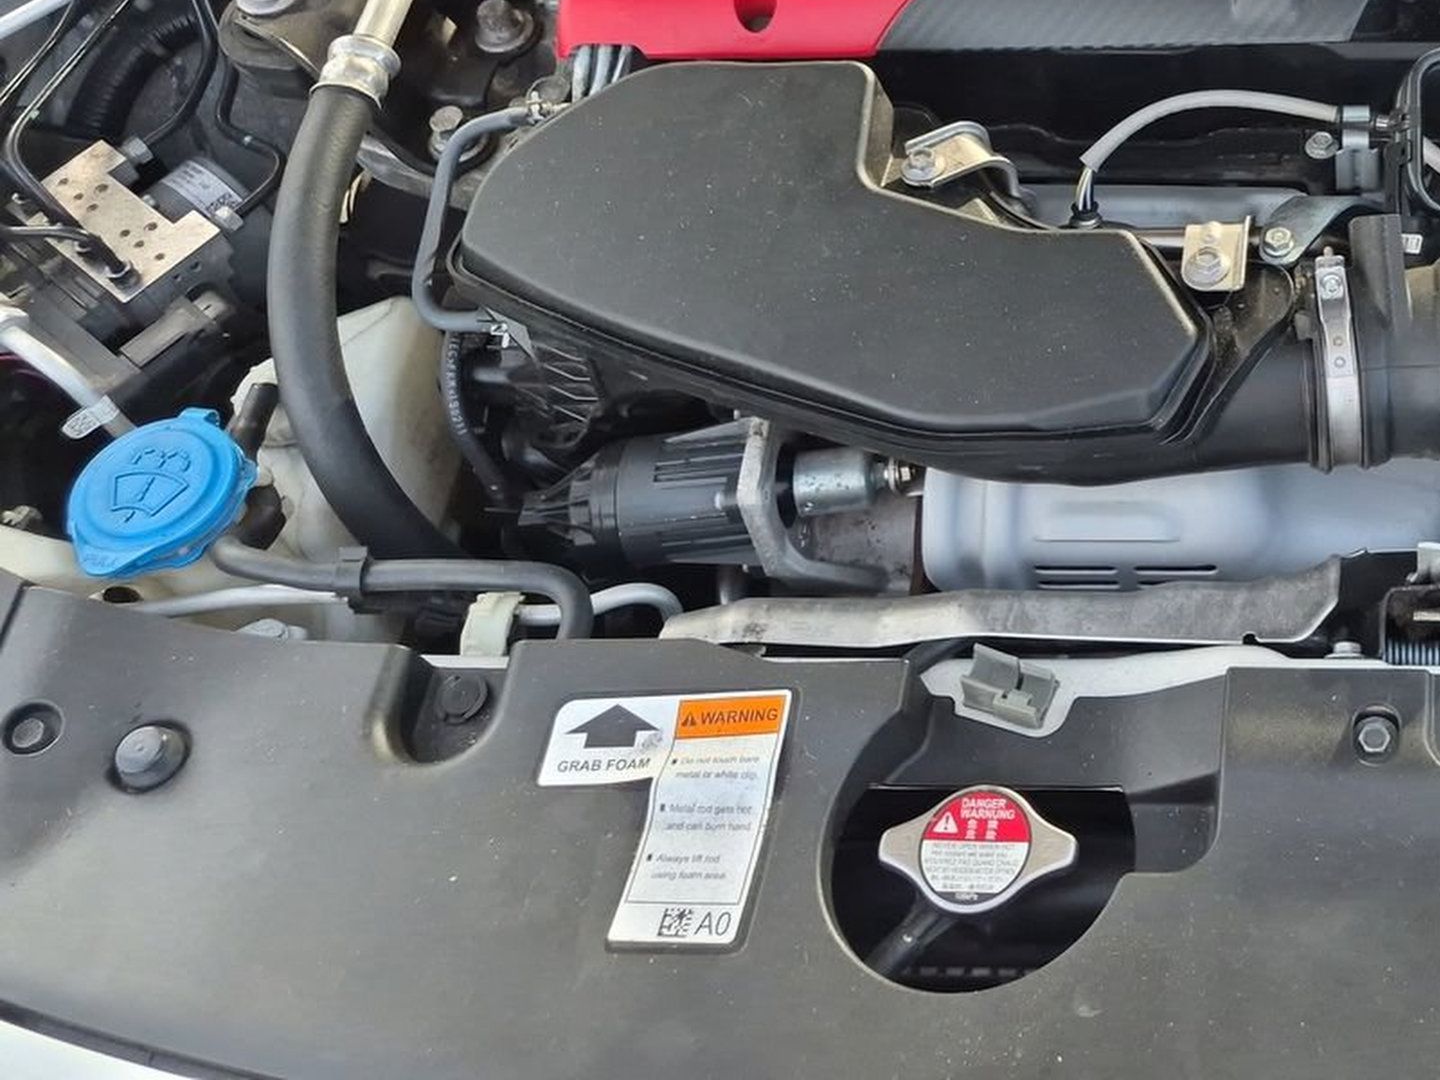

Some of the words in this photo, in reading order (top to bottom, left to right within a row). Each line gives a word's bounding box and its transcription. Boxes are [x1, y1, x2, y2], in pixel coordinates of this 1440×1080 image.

[701, 708, 778, 725] WARNING
[557, 759, 600, 773] GRAB
[606, 757, 651, 771] FOAM
[961, 797, 1007, 808] DANGER
[696, 804, 712, 813] rod
[714, 804, 735, 815] gets
[665, 822, 685, 830] and
[656, 854, 690, 864] Always
[703, 854, 721, 863] rod
[678, 871, 702, 879] foam
[694, 911, 732, 936] A0
